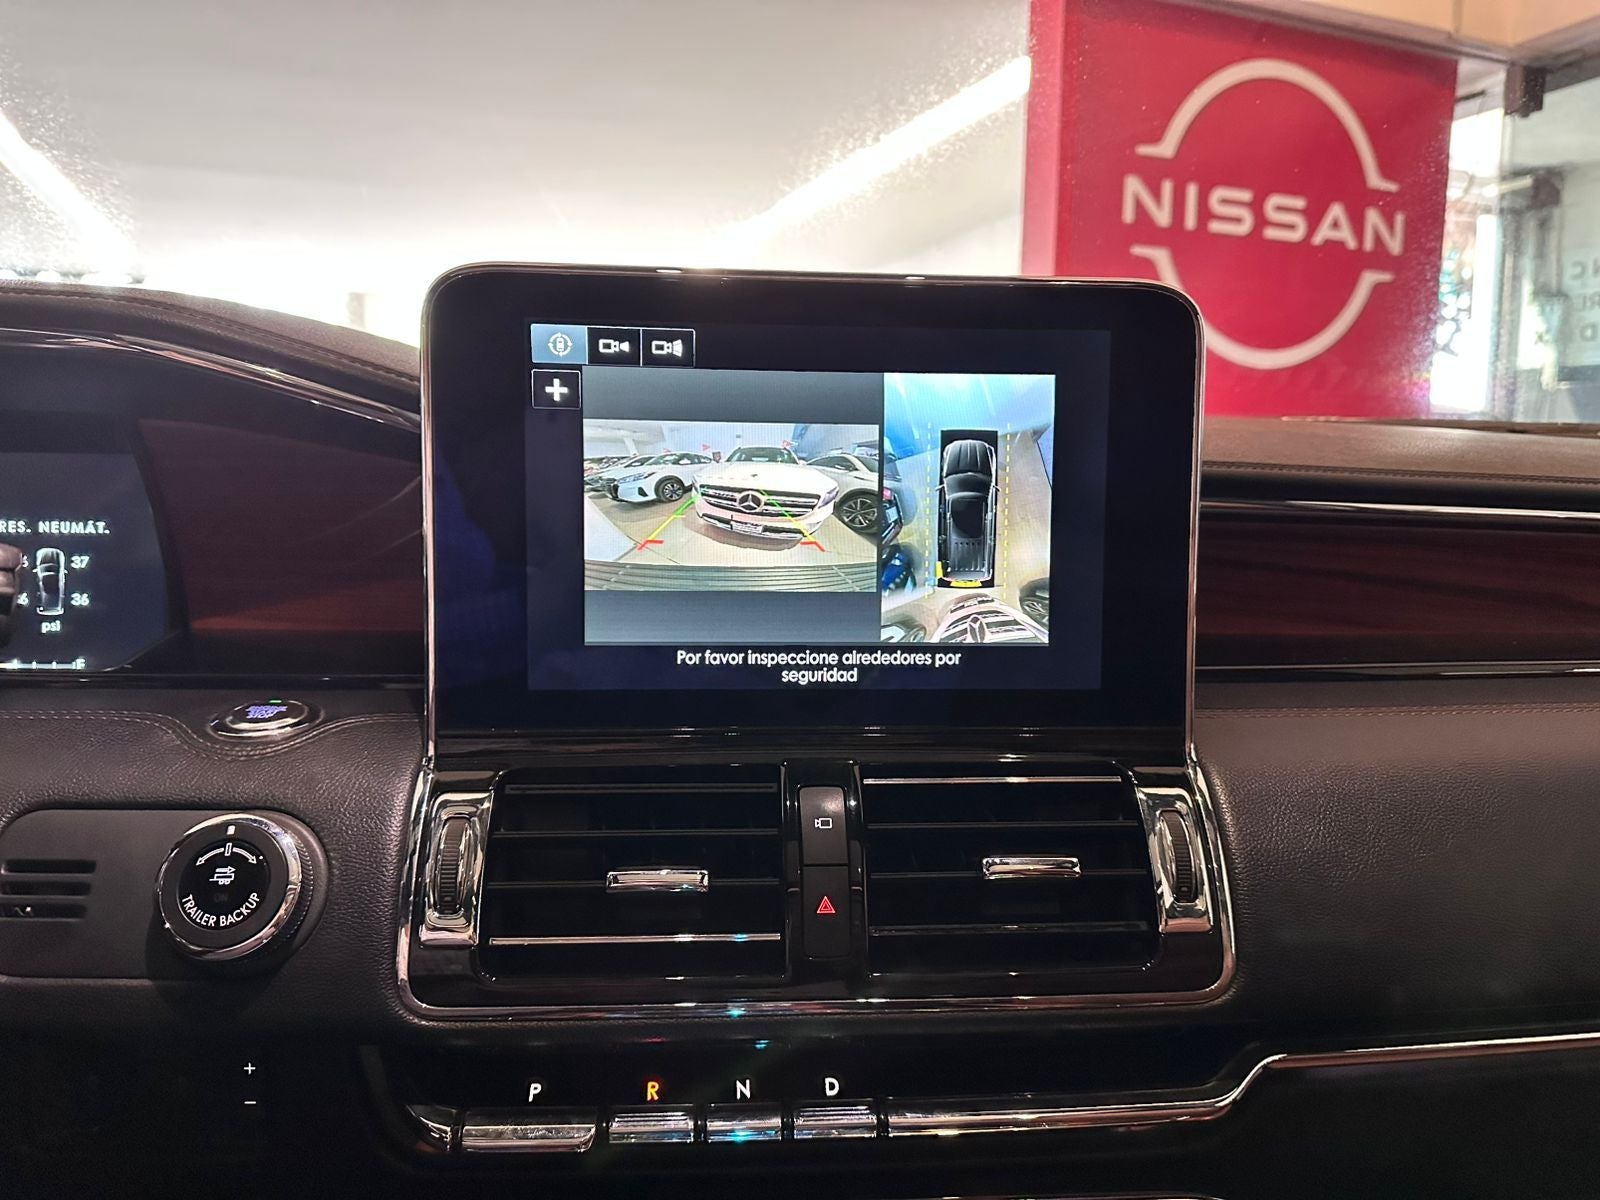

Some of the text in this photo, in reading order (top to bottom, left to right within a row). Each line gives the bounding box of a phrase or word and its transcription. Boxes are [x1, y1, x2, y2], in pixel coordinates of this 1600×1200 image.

[1121, 173, 1406, 257] NISSAN
[38, 520, 110, 534] NEUMÁT.
[70, 556, 90, 569] 37
[70, 592, 90, 606] 36
[41, 620, 61, 634] psi
[676, 650, 962, 668] Por favor inspeccione alrededores por
[781, 667, 858, 685] seguridad
[182, 892, 261, 927] TRAILER BACKUP
[528, 1082, 542, 1102] P
[647, 1081, 659, 1101] R
[736, 1079, 751, 1099] N
[825, 1077, 840, 1097] D
